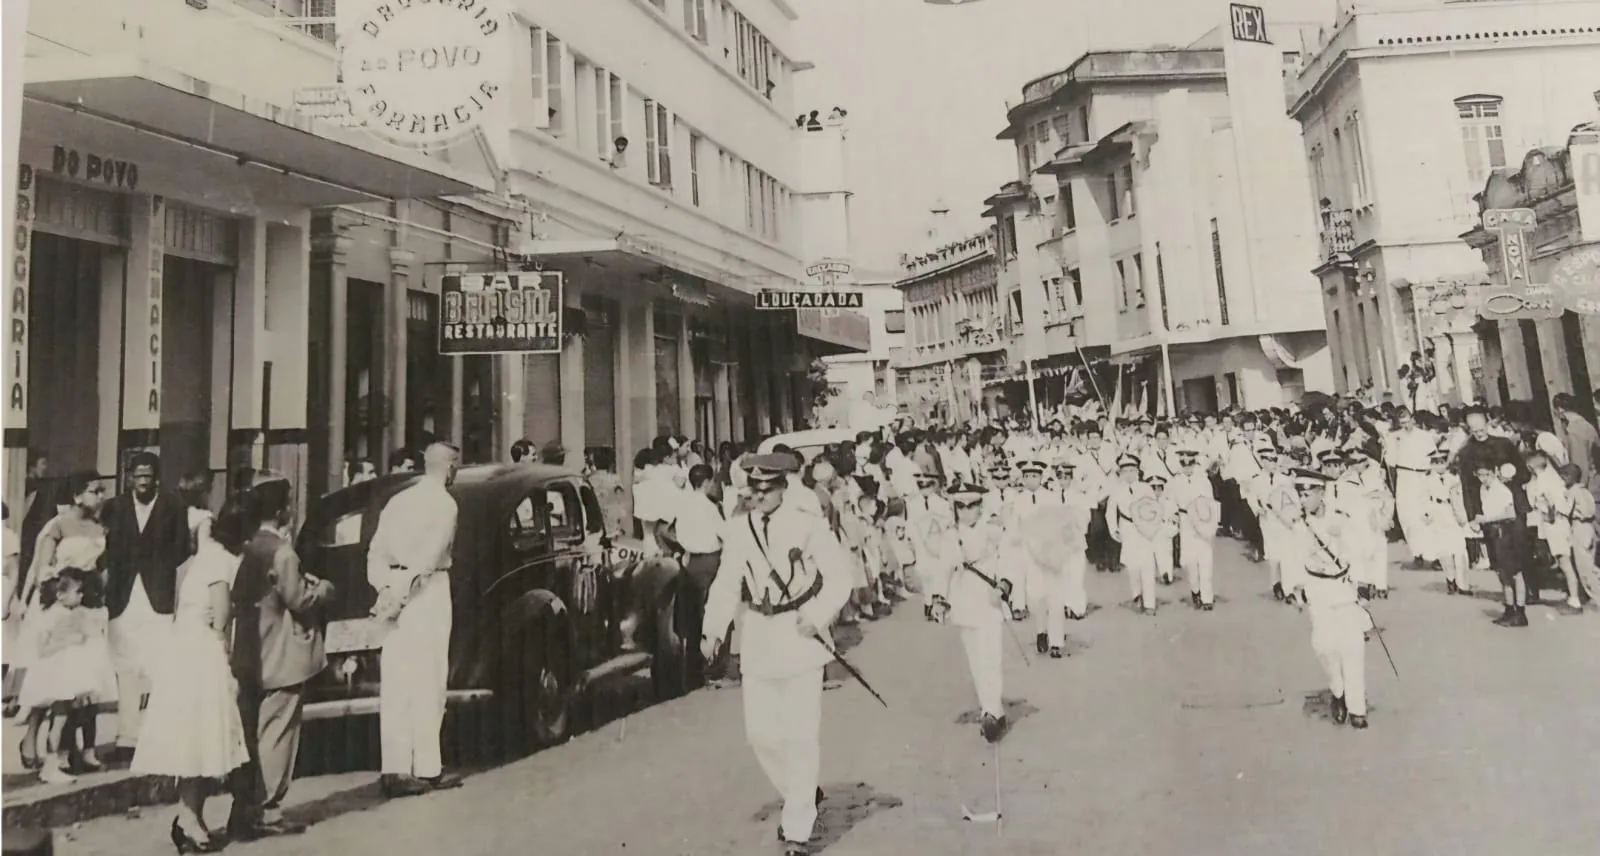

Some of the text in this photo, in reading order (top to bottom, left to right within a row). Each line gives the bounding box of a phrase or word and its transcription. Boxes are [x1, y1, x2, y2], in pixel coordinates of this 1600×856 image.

[1231, 5, 1266, 41] REX
[397, 45, 481, 73] POVO
[357, 81, 499, 134] FARMACIA
[53, 144, 139, 190] DO POVO
[1507, 232, 1524, 280] NOVA
[460, 272, 542, 291] BAR
[444, 323, 557, 339] RESTAURANTE
